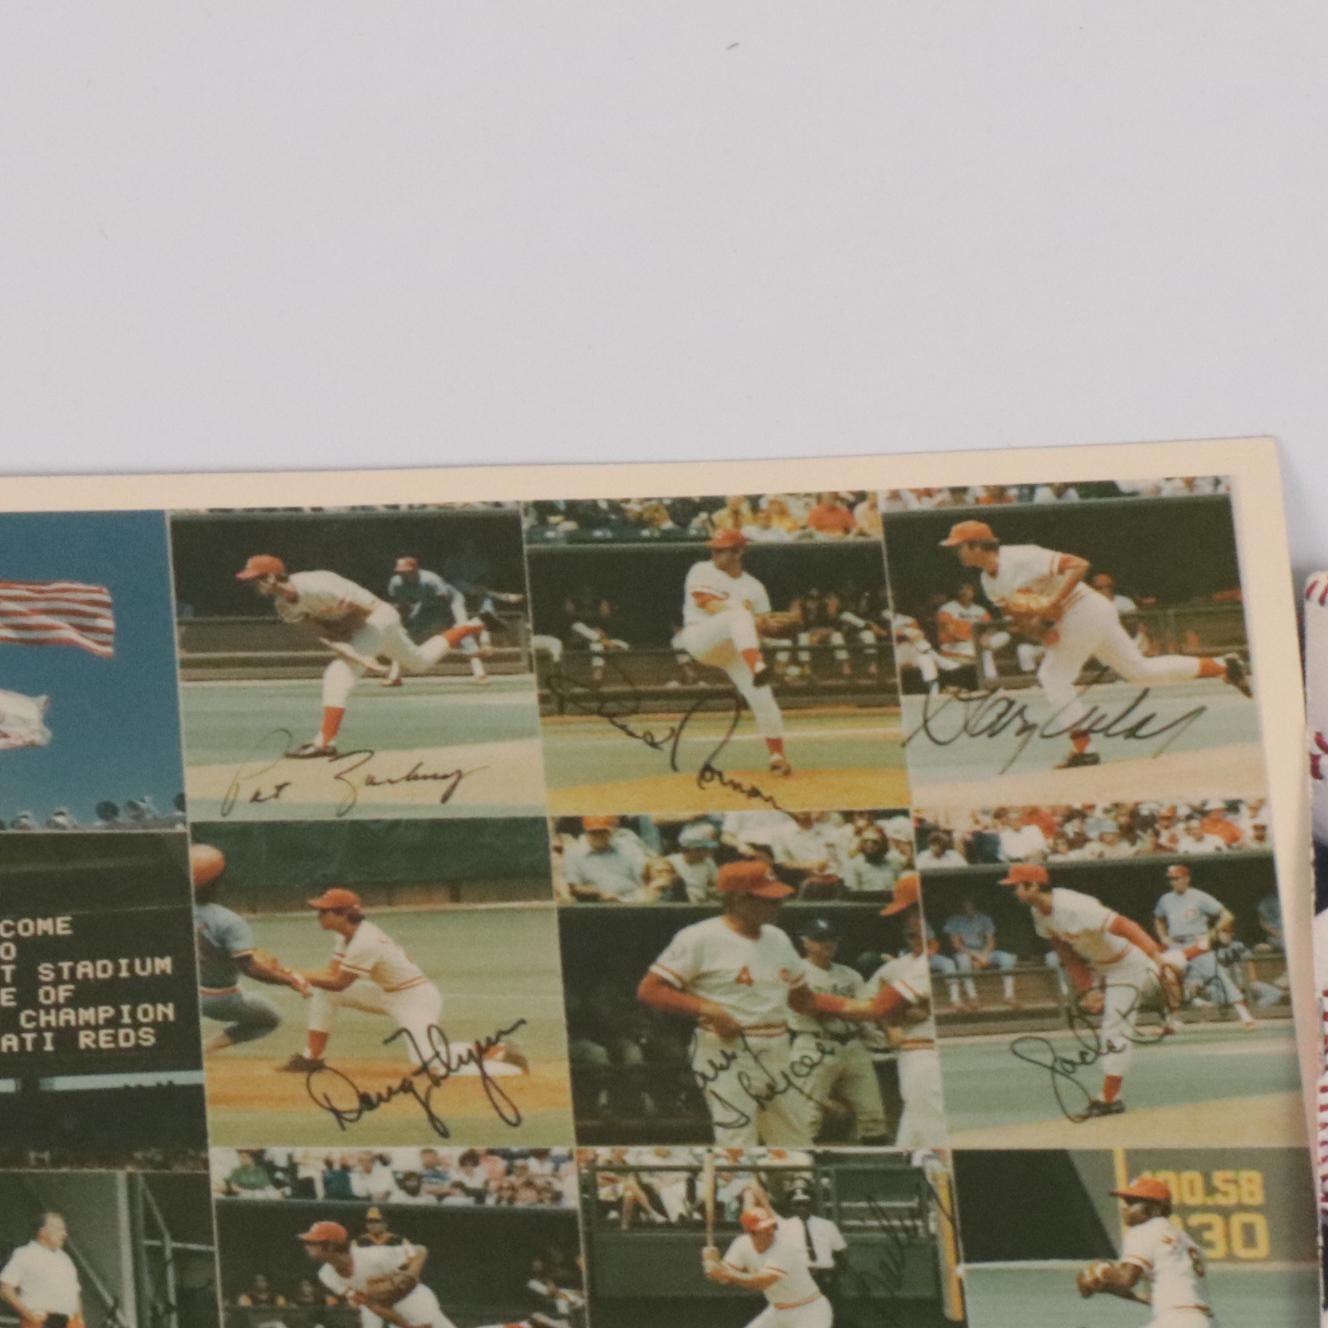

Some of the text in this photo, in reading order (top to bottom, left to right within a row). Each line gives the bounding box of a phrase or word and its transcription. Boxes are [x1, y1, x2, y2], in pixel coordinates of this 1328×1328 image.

[38, 956, 172, 982] STADIUM
[38, 985, 75, 1004] OF
[20, 1003, 175, 1029] CHAMPION
[79, 1028, 156, 1050] REDS
